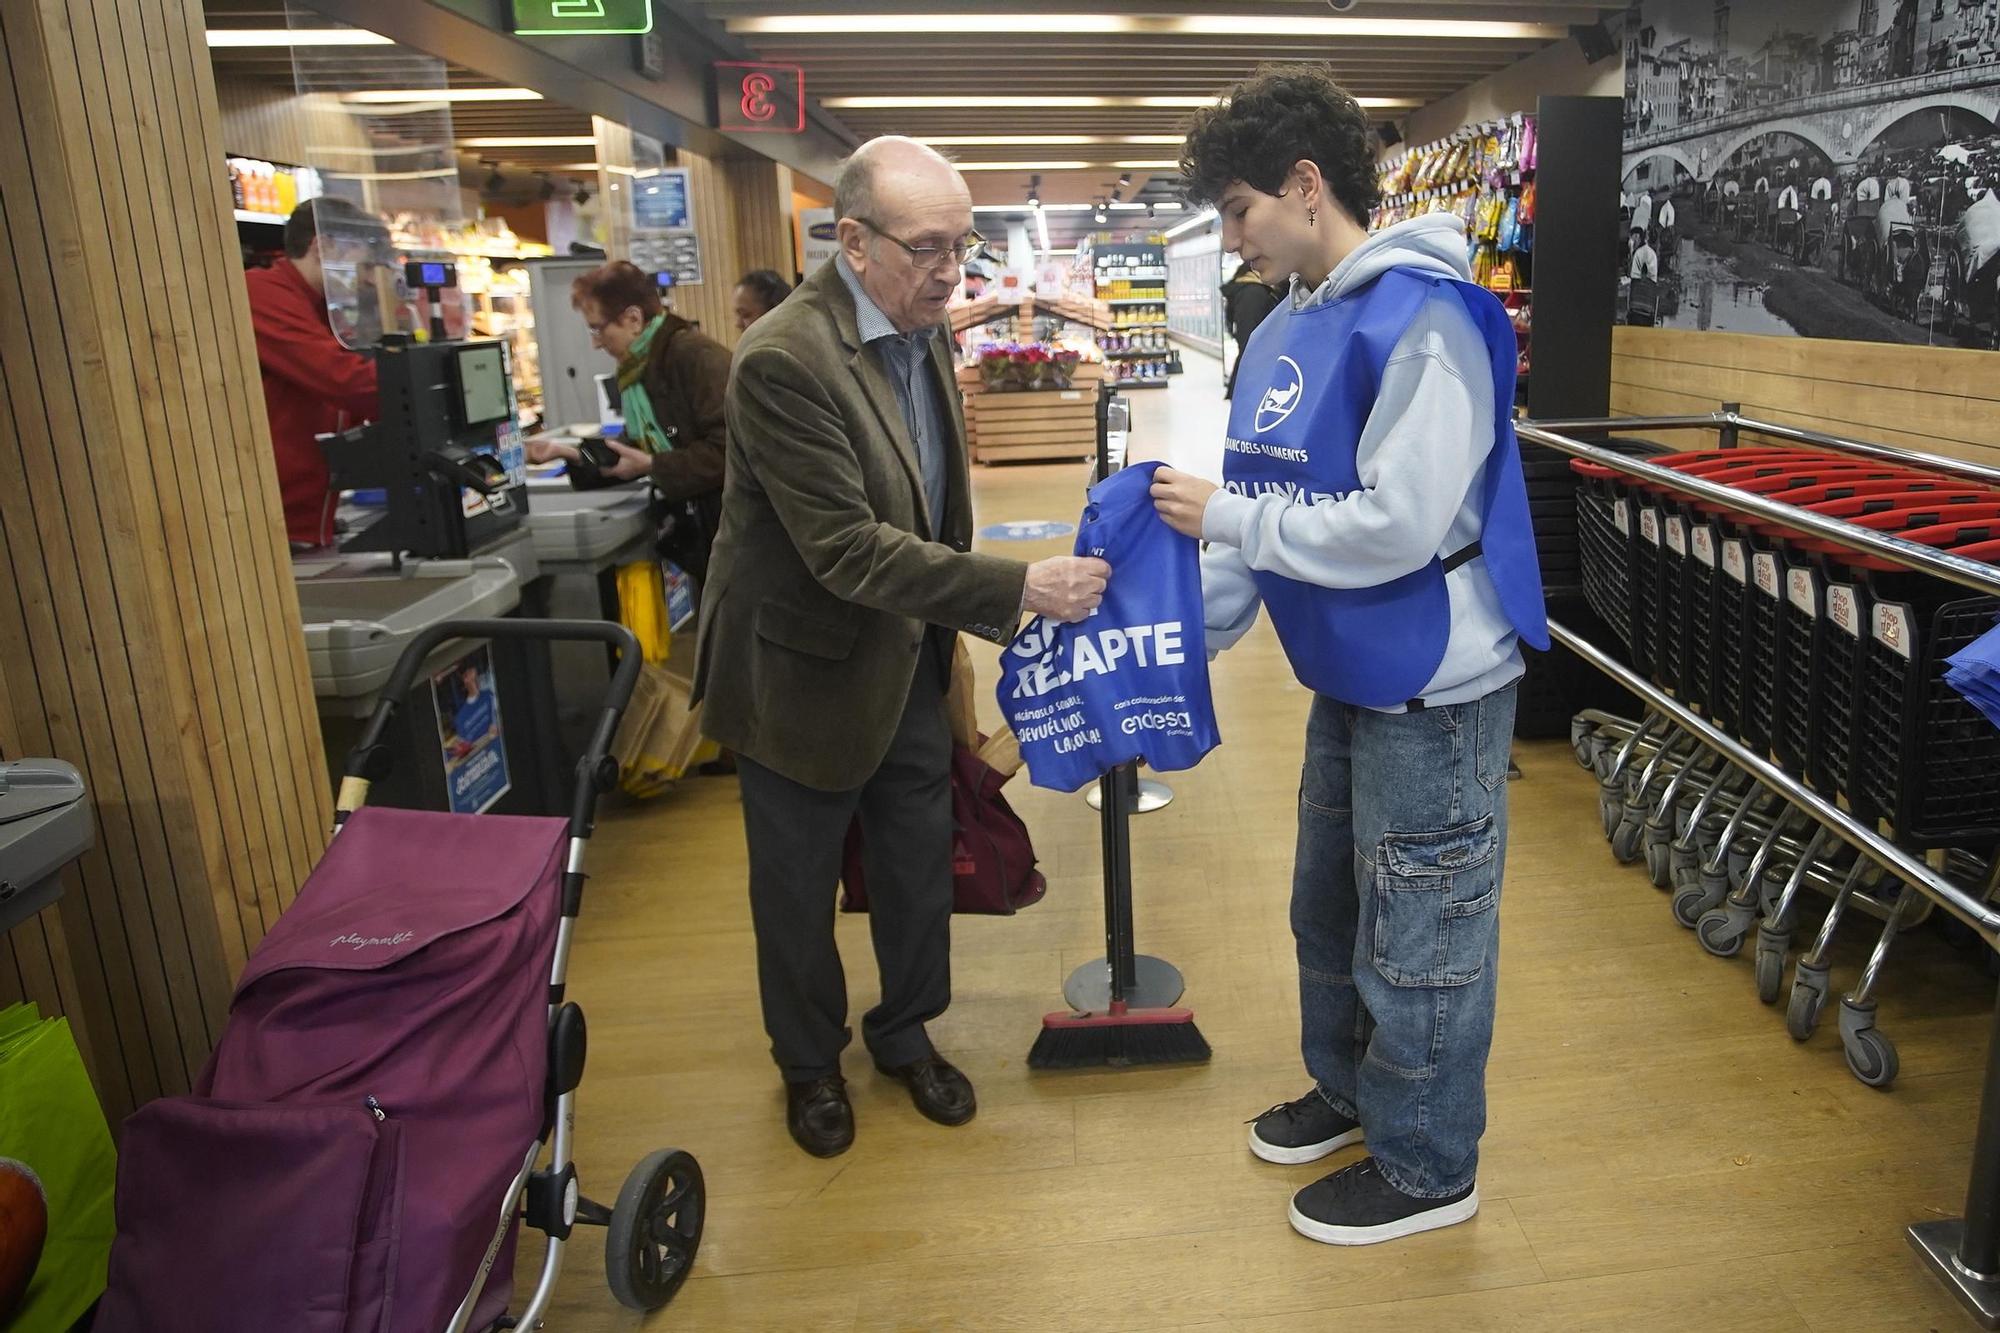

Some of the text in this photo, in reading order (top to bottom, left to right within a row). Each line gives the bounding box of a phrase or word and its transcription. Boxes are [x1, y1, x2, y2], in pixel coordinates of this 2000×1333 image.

[1240, 440, 1261, 454] DELS
[1261, 444, 1308, 463] ALIMENTS
[1833, 588, 1848, 605] Shop
[1881, 606, 1898, 625] Shop
[1121, 709, 1191, 735] endesa
